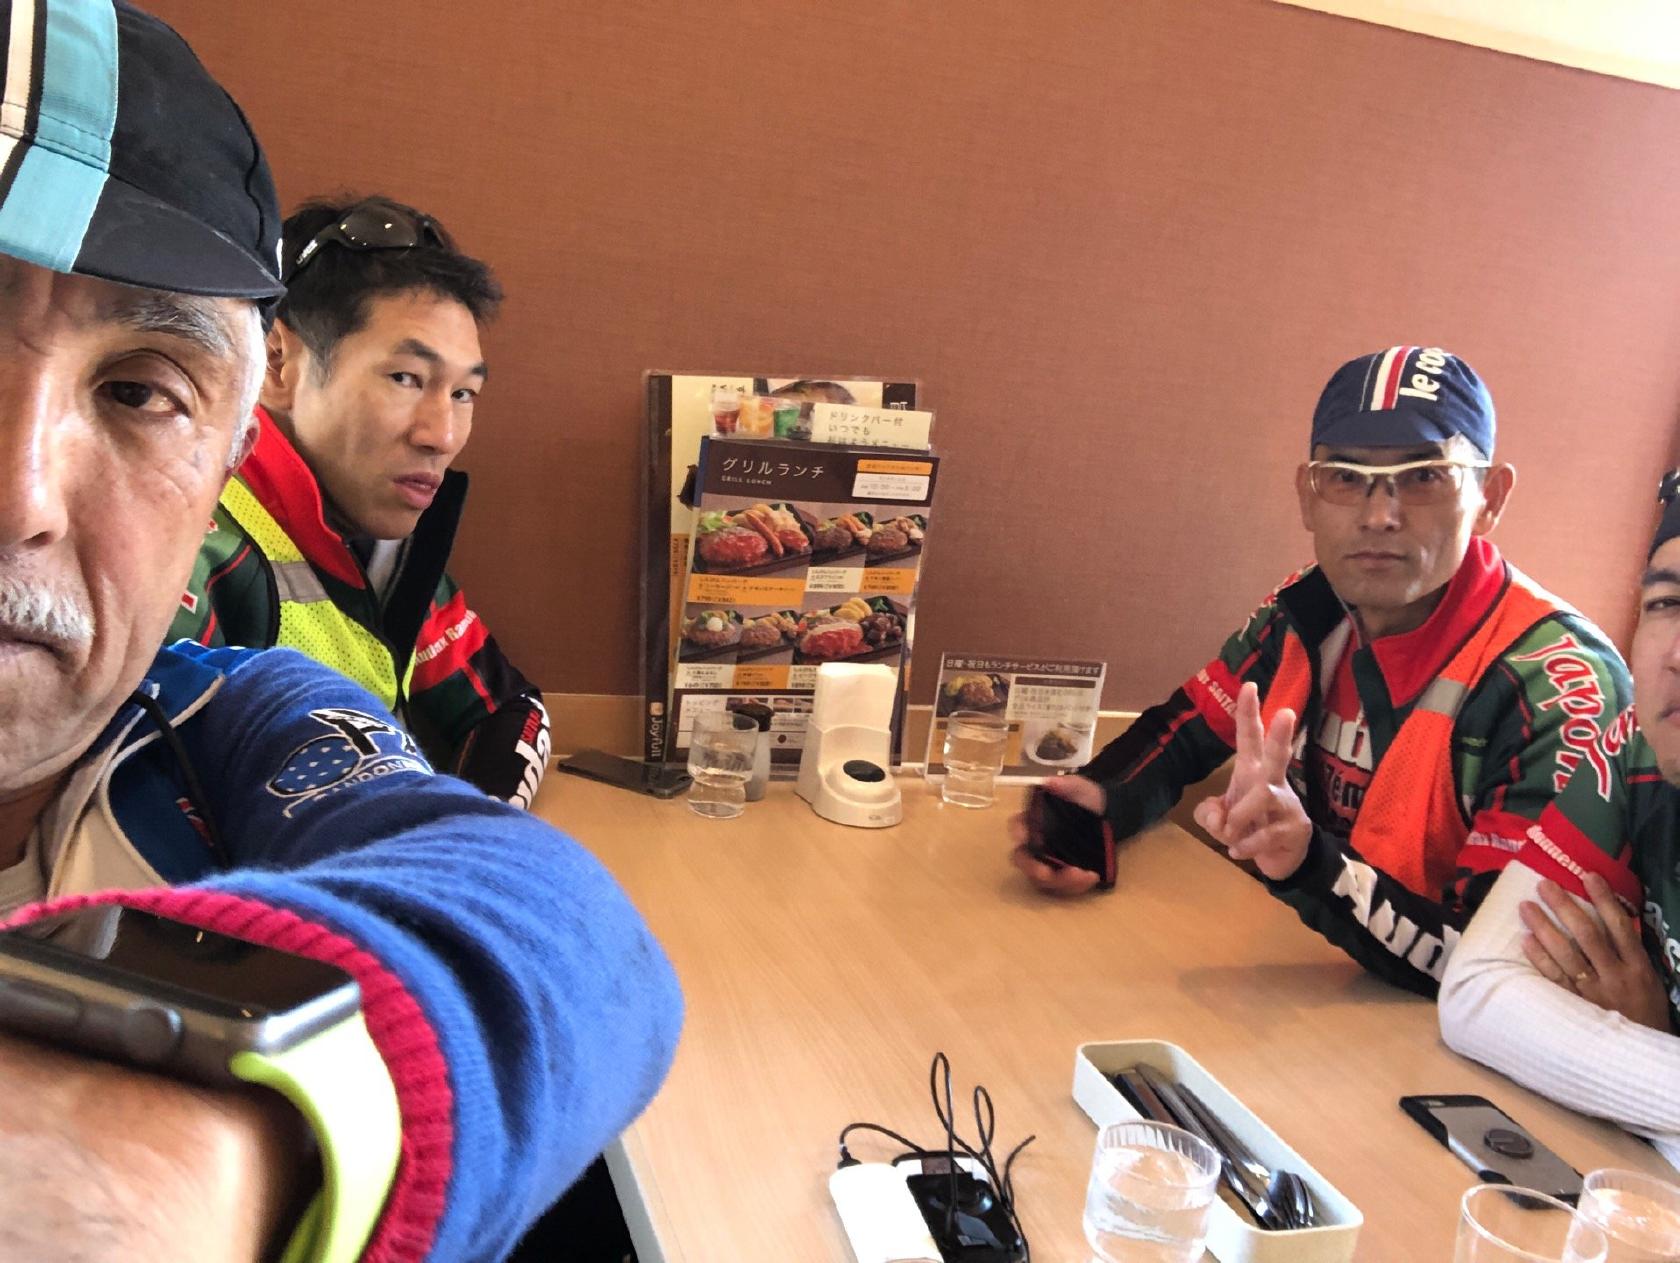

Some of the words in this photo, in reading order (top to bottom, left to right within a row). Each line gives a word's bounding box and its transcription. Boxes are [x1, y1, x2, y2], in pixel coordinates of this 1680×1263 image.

[1399, 373, 1440, 402] le
[722, 457, 825, 479] グリルランチ
